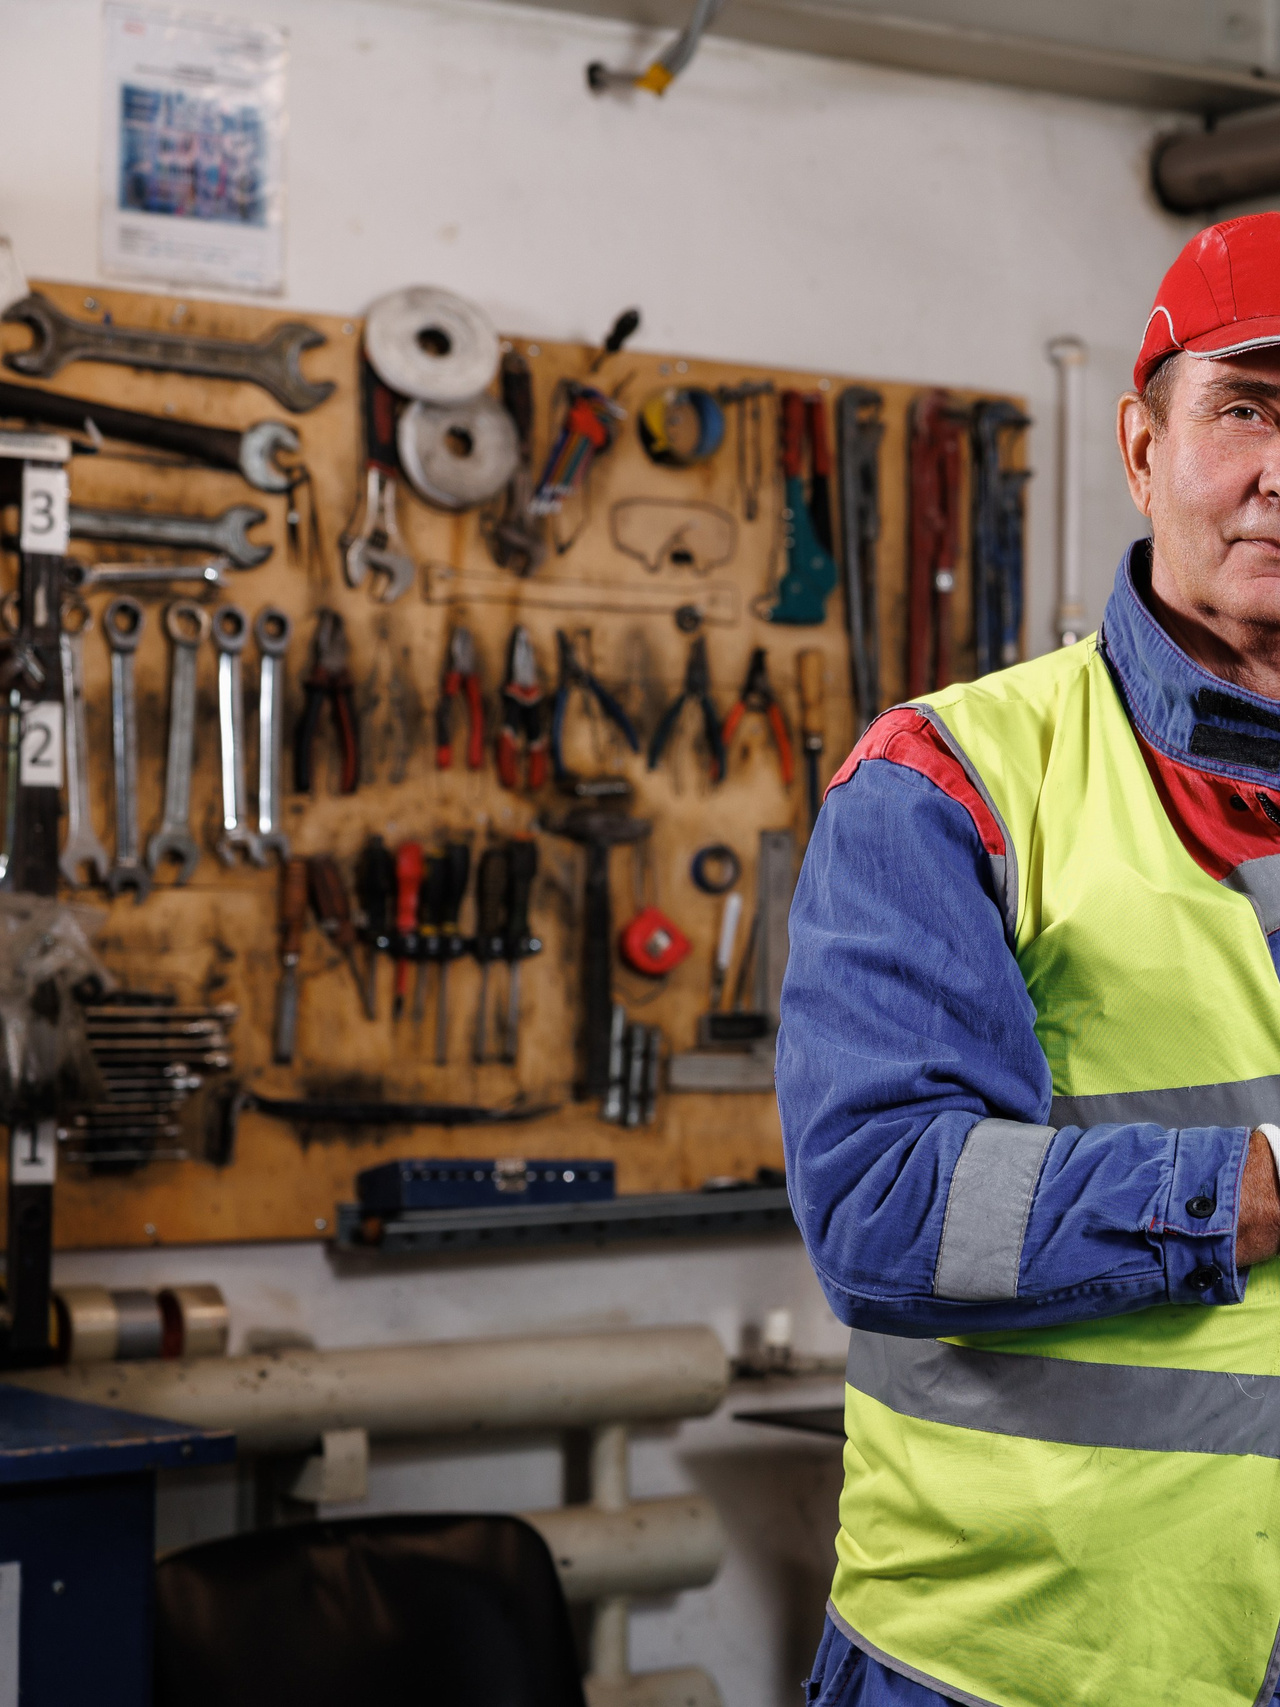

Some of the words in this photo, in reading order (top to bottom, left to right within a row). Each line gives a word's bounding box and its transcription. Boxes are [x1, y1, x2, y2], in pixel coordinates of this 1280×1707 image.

[29, 490, 55, 535] 3
[28, 722, 53, 768] 2
[22, 1124, 45, 1167] 1
